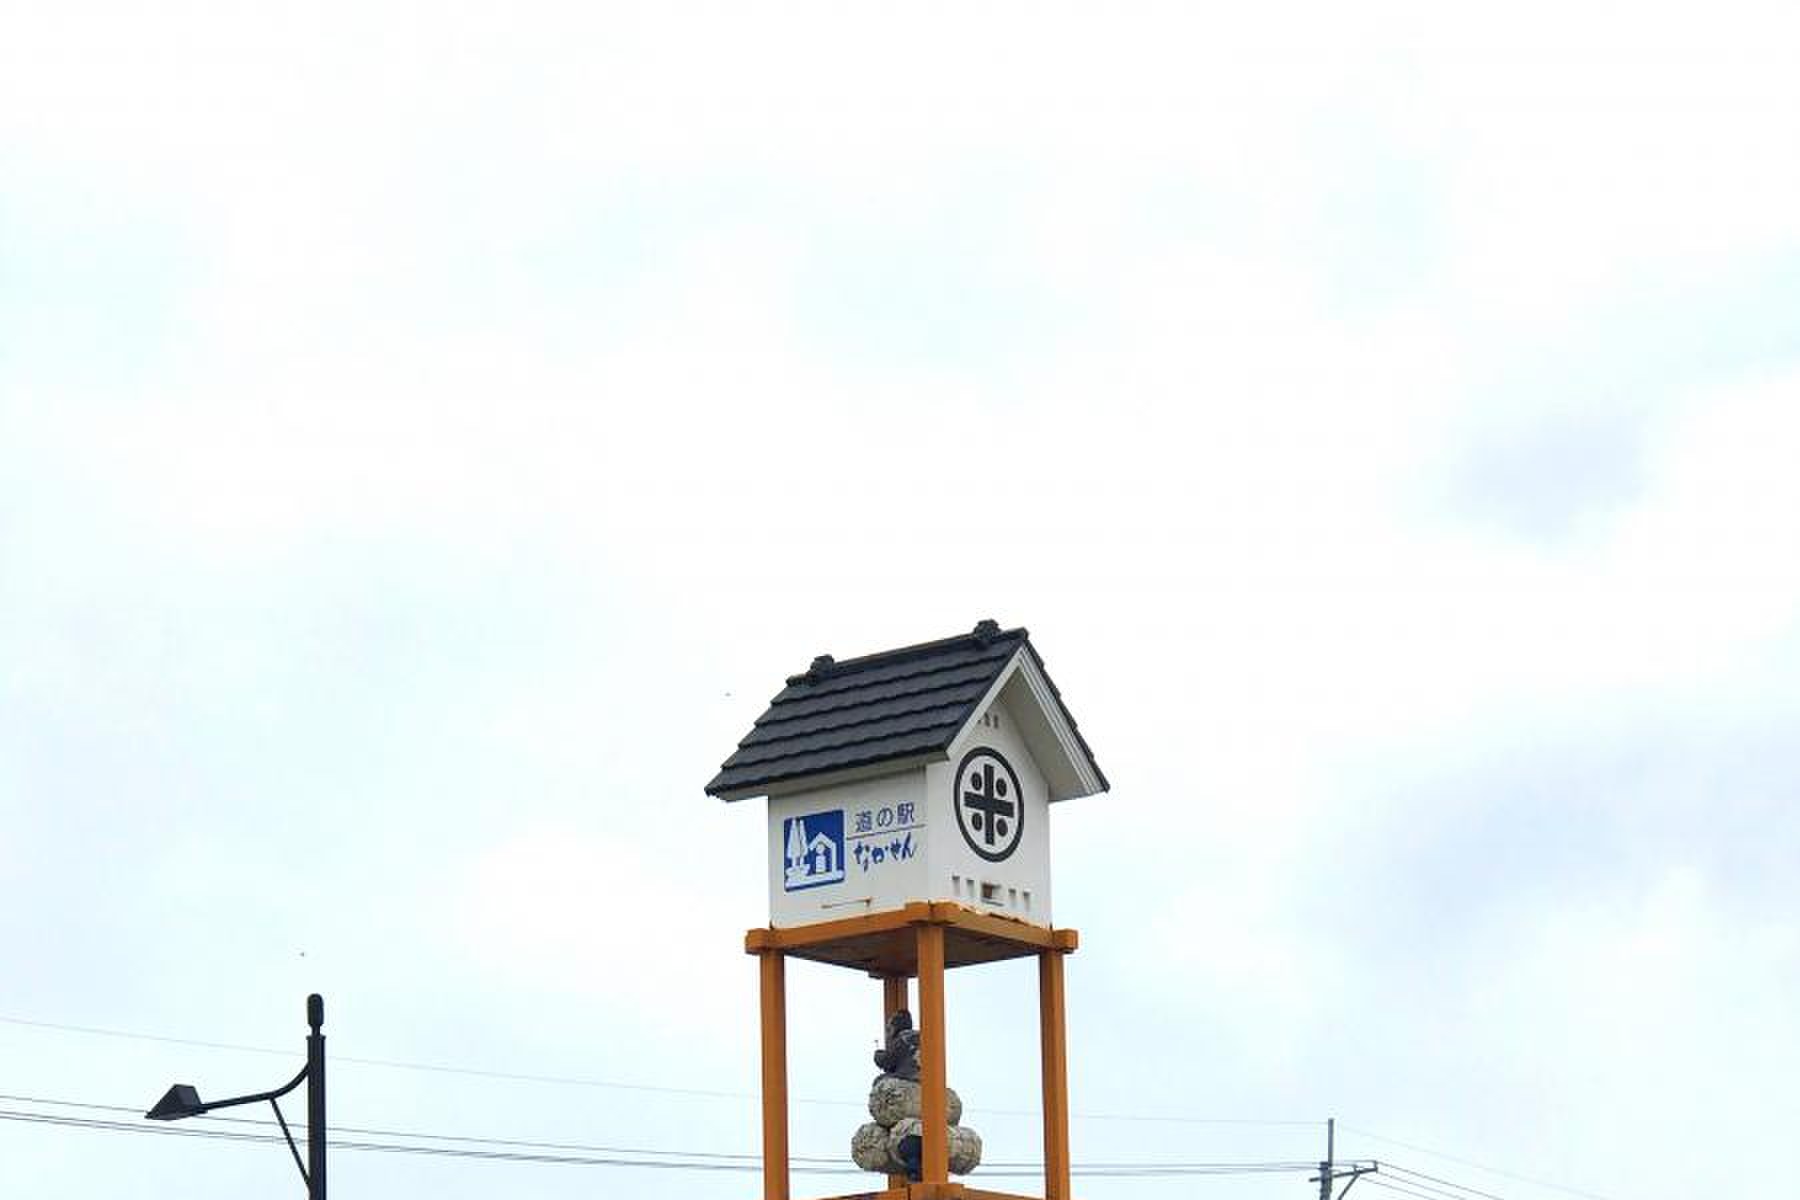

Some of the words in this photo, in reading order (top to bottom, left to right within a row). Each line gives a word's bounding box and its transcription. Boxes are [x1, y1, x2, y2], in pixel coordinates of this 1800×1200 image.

[855, 802, 914, 833] 道の駅
[853, 832, 918, 872] なかせん
